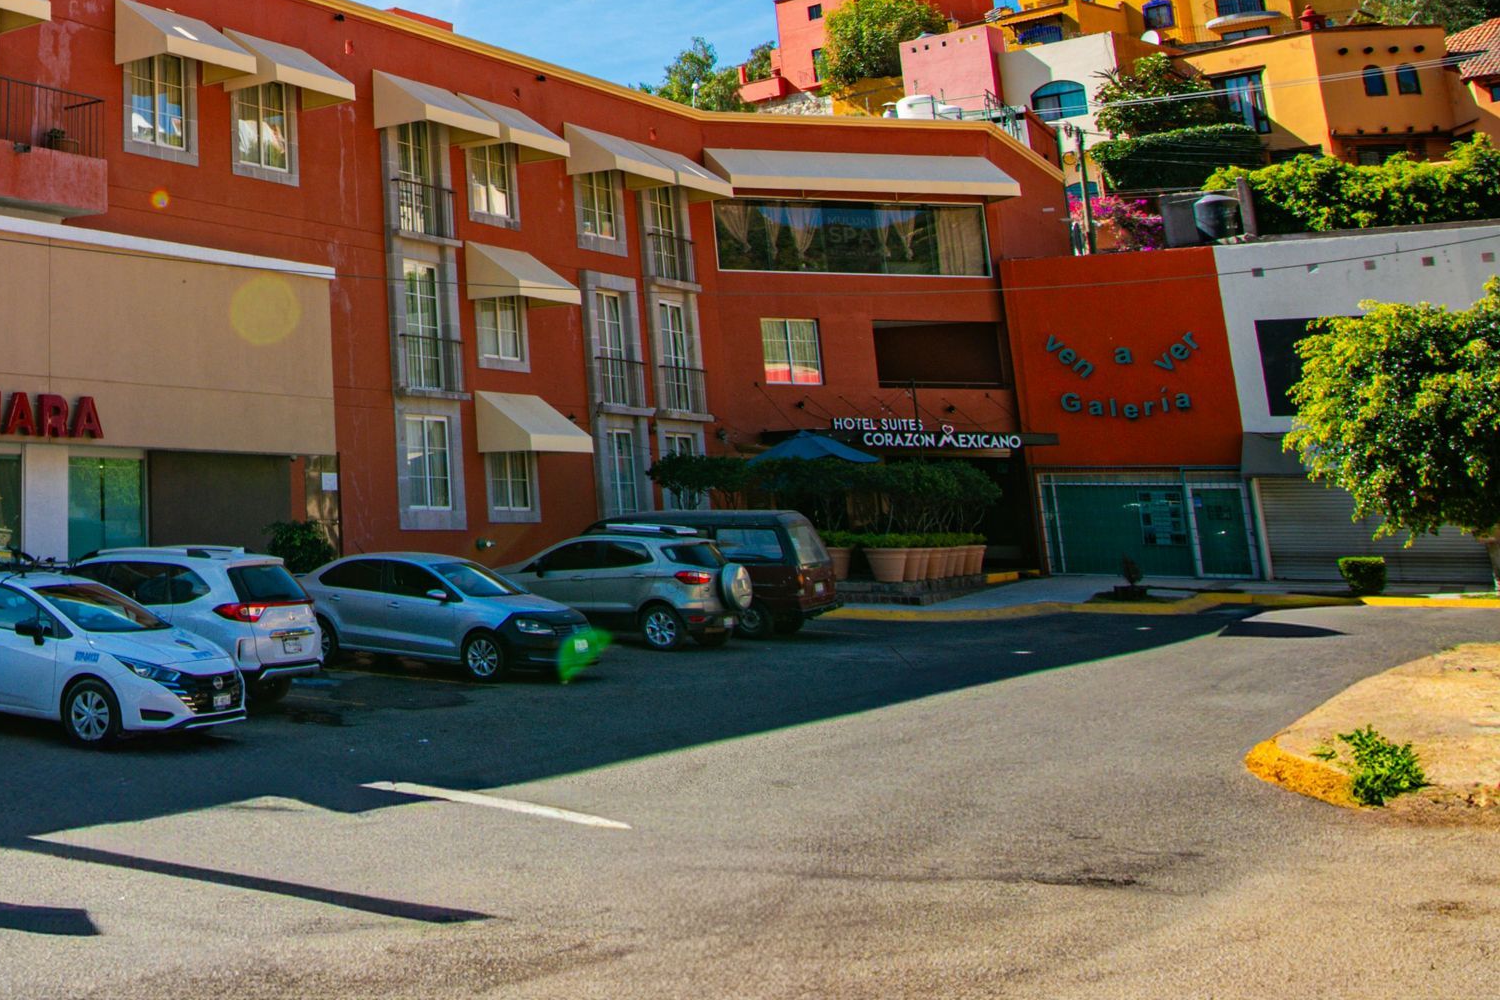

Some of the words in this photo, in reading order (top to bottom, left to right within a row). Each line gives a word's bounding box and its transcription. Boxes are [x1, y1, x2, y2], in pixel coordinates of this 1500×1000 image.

[828, 226, 875, 244] SPA
[1046, 334, 1094, 378] ven
[1114, 347, 1132, 364] a
[1153, 331, 1198, 371] ver
[1060, 386, 1191, 418] Galería
[833, 417, 877, 431] HOTEL
[937, 433, 1022, 448] MEXICANO
